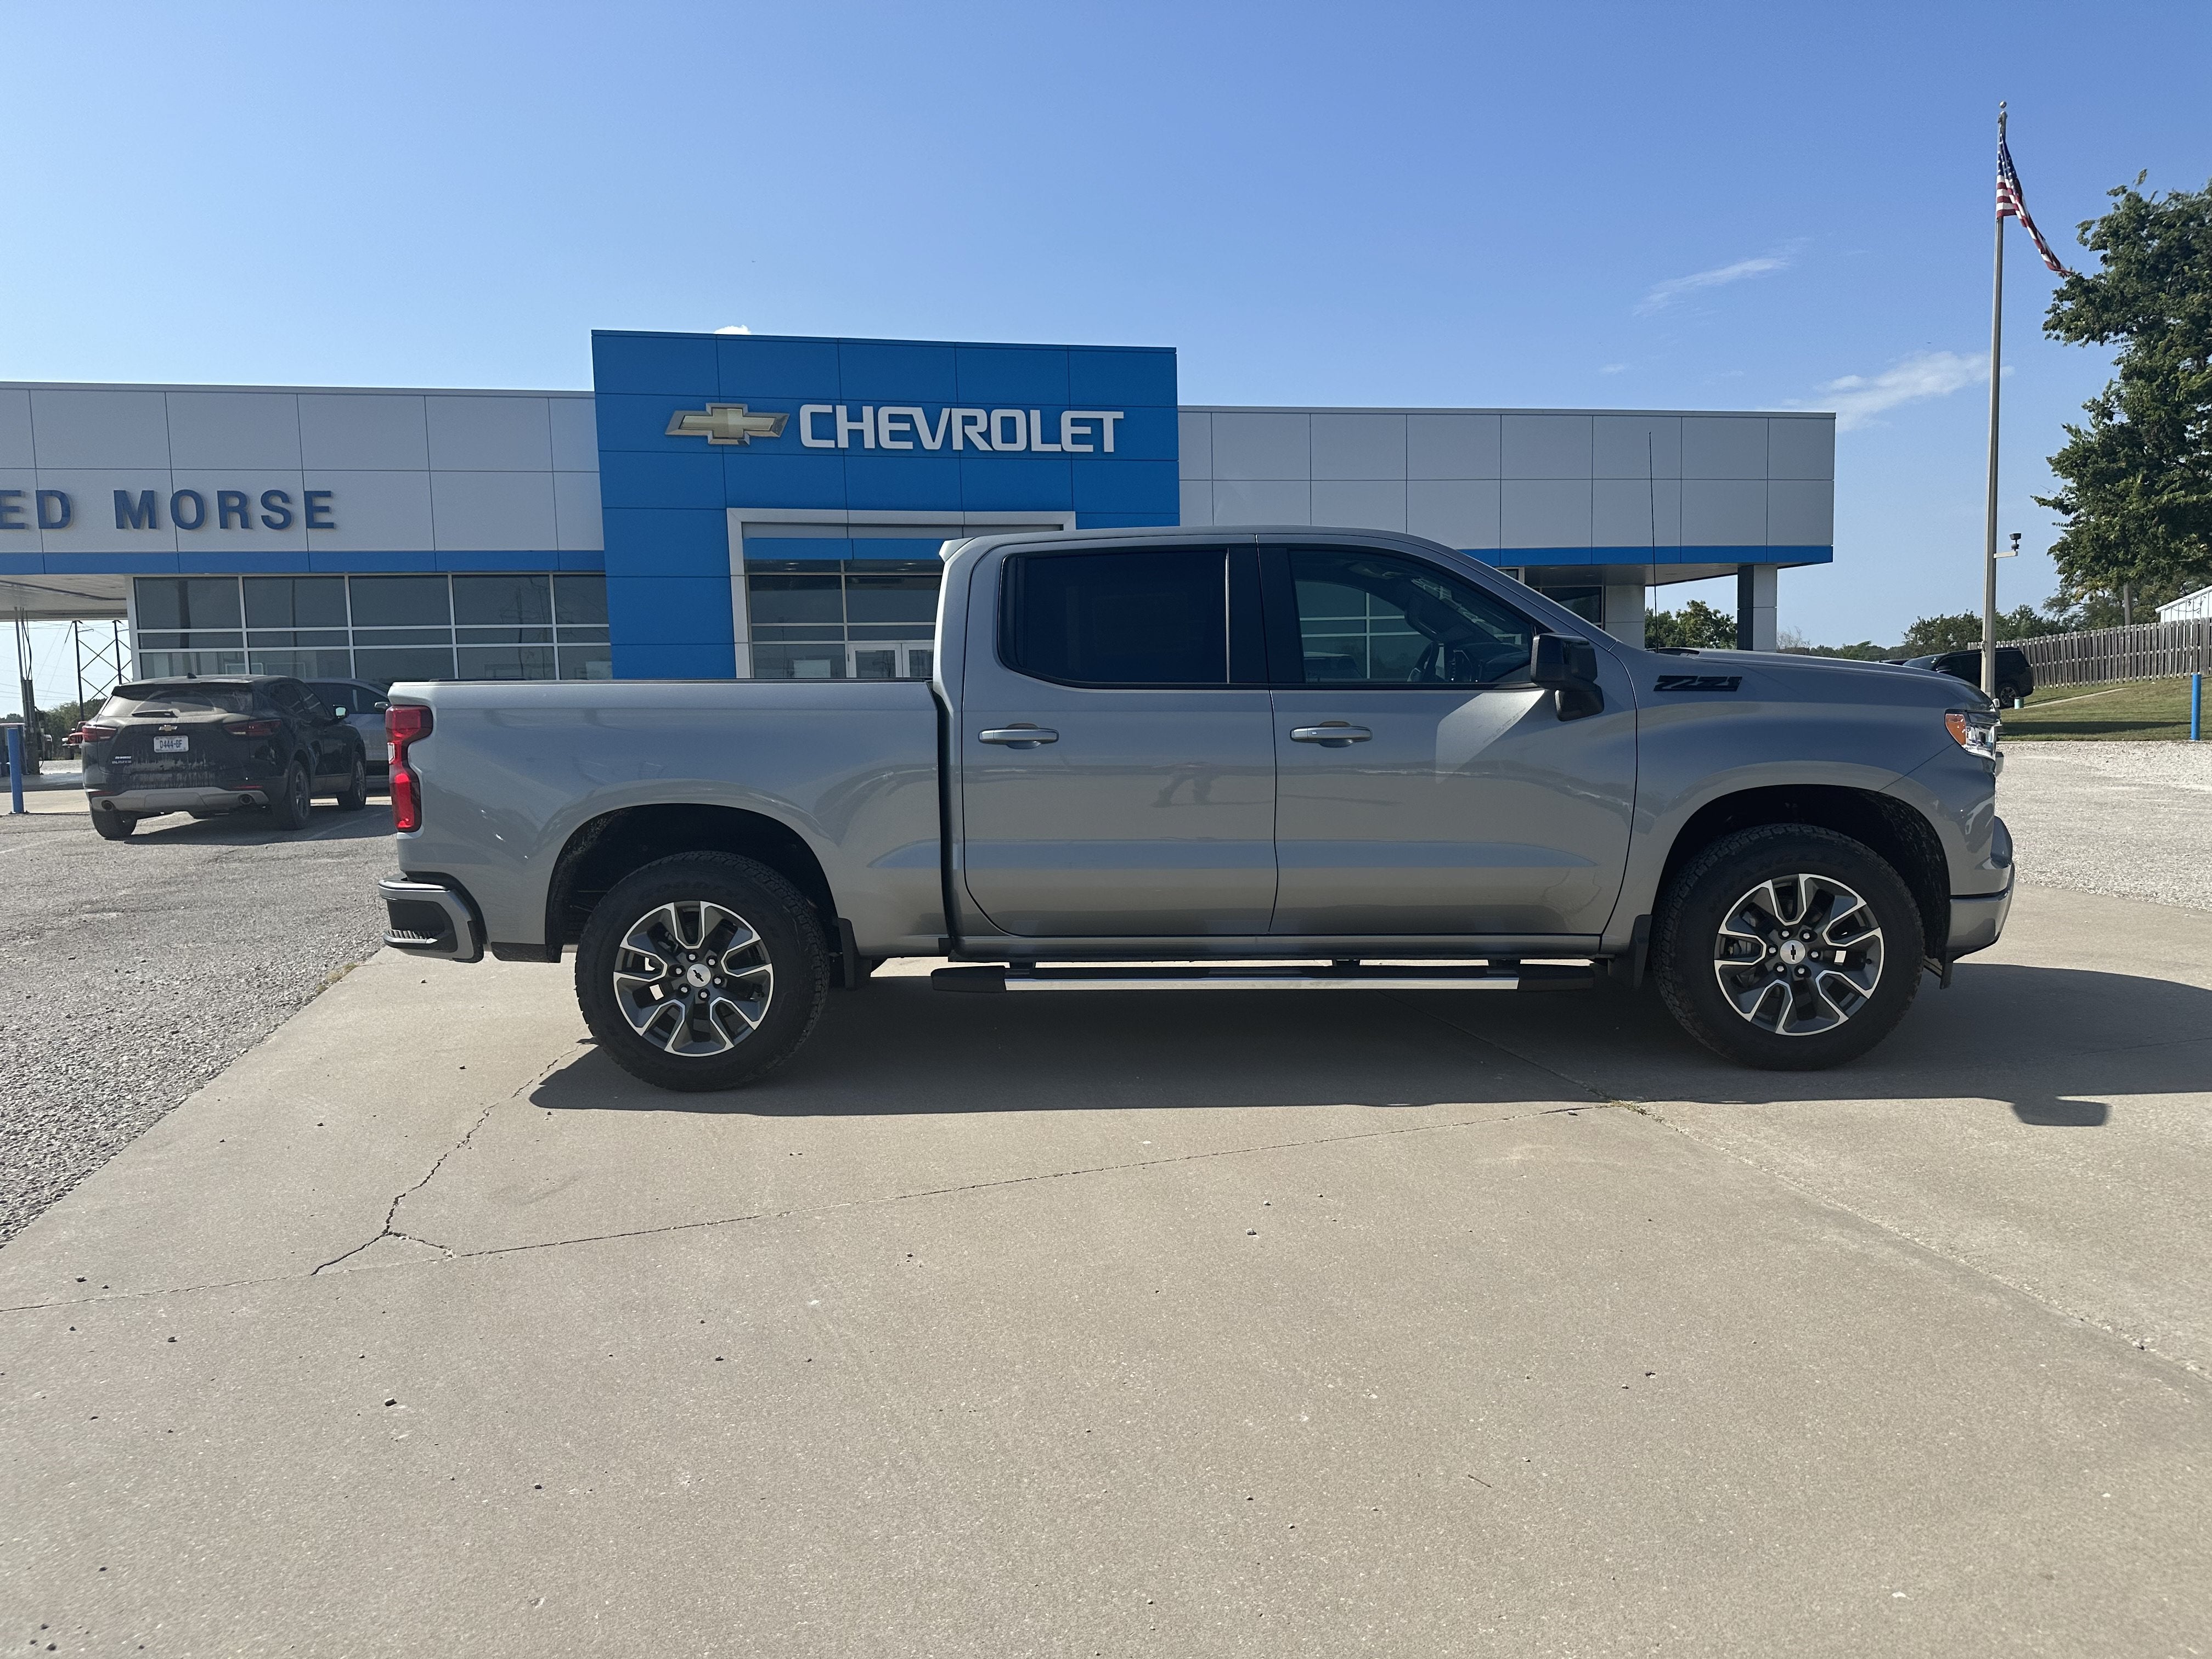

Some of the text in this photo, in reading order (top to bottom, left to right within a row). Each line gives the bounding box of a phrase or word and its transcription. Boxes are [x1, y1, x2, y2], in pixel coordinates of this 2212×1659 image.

[799, 404, 1125, 453] CHEVROLET
[0, 489, 335, 530] ED MORSE
[1654, 675, 1743, 692] Z71
